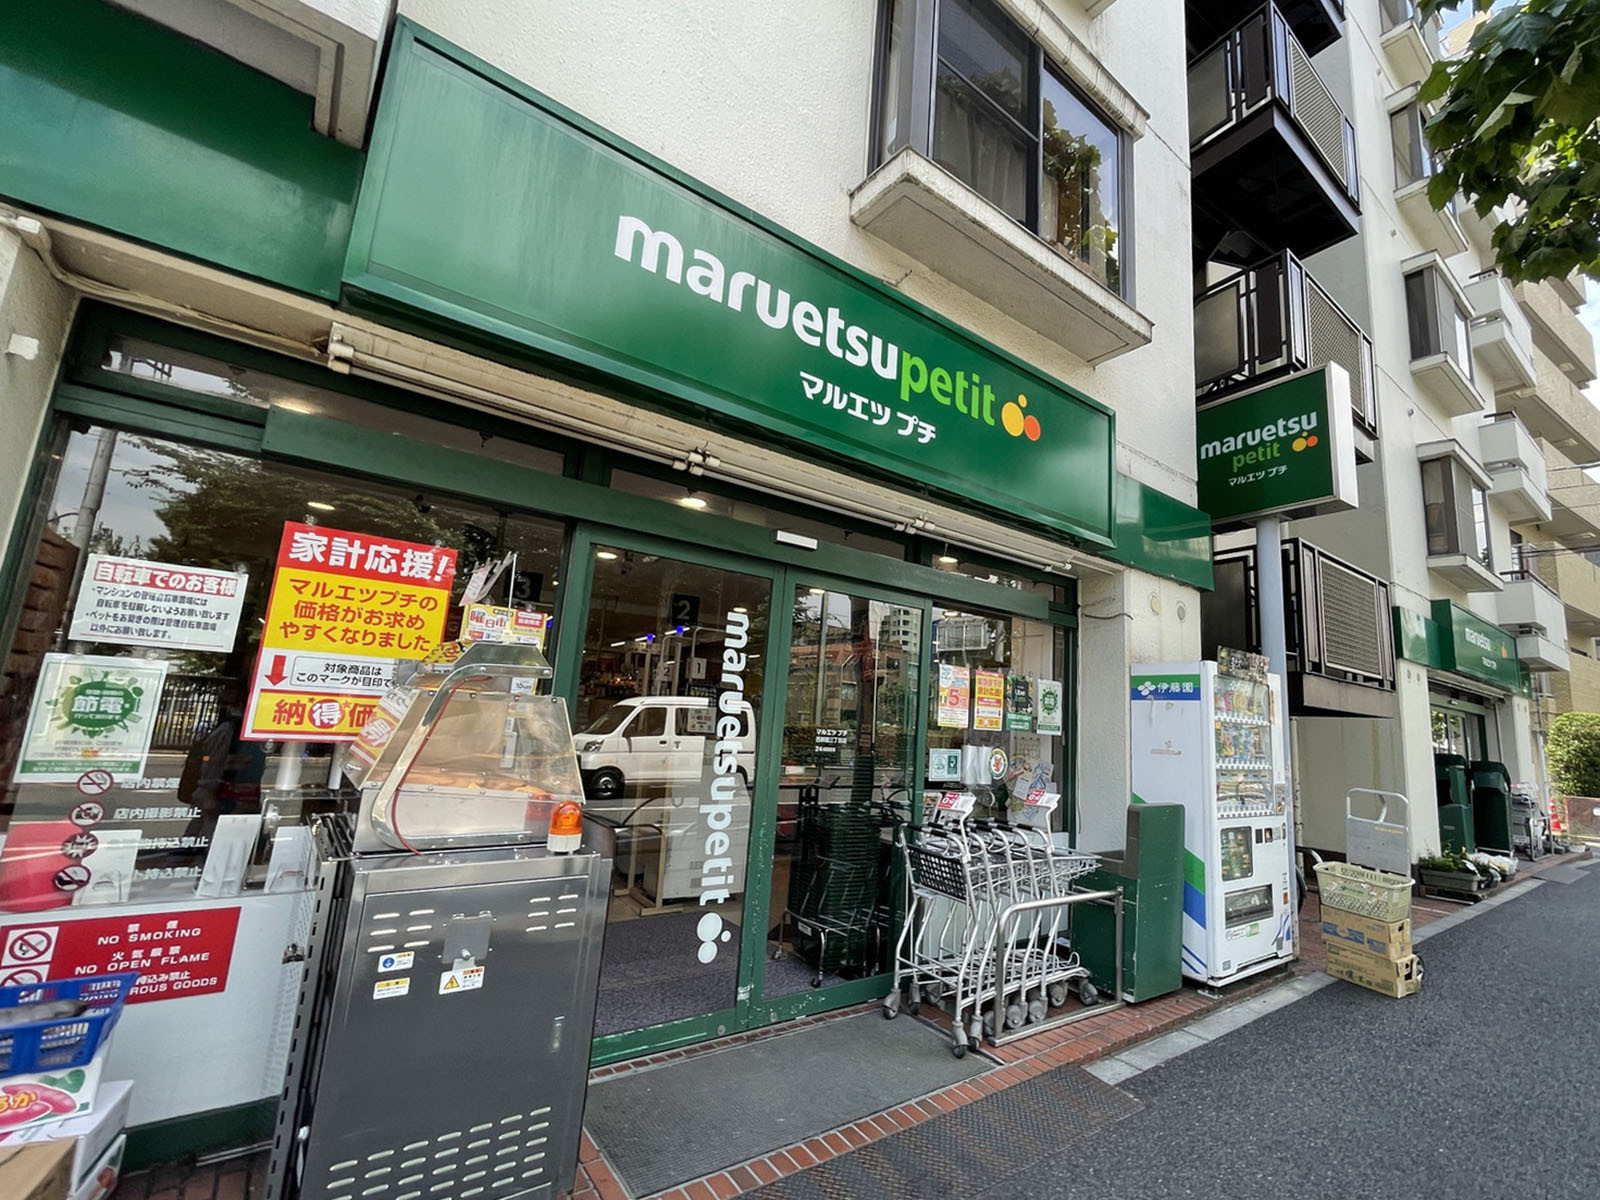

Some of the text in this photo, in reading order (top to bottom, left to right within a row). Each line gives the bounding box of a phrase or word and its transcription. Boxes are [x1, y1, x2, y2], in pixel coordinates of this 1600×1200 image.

[1200, 411, 1318, 460] maruetsu
[1232, 441, 1281, 473] petit
[95, 562, 238, 597] 自転車でのお客様
[289, 576, 439, 612] マルエツプチの
[293, 600, 425, 631] 価格がお求め
[677, 600, 691, 620] 2
[280, 621, 432, 653] やすくなりました
[323, 662, 382, 677] 対象商品は
[663, 667, 671, 677] 2
[695, 663, 702, 674] 1
[296, 674, 398, 690] このマークが目印で
[1157, 681, 1194, 694] 伊藤園
[273, 697, 379, 730] 納得価
[97, 927, 201, 946] NO SMOKING
[75, 952, 210, 975] NO OPEN FLAME
[172, 977, 218, 991] GOODS
